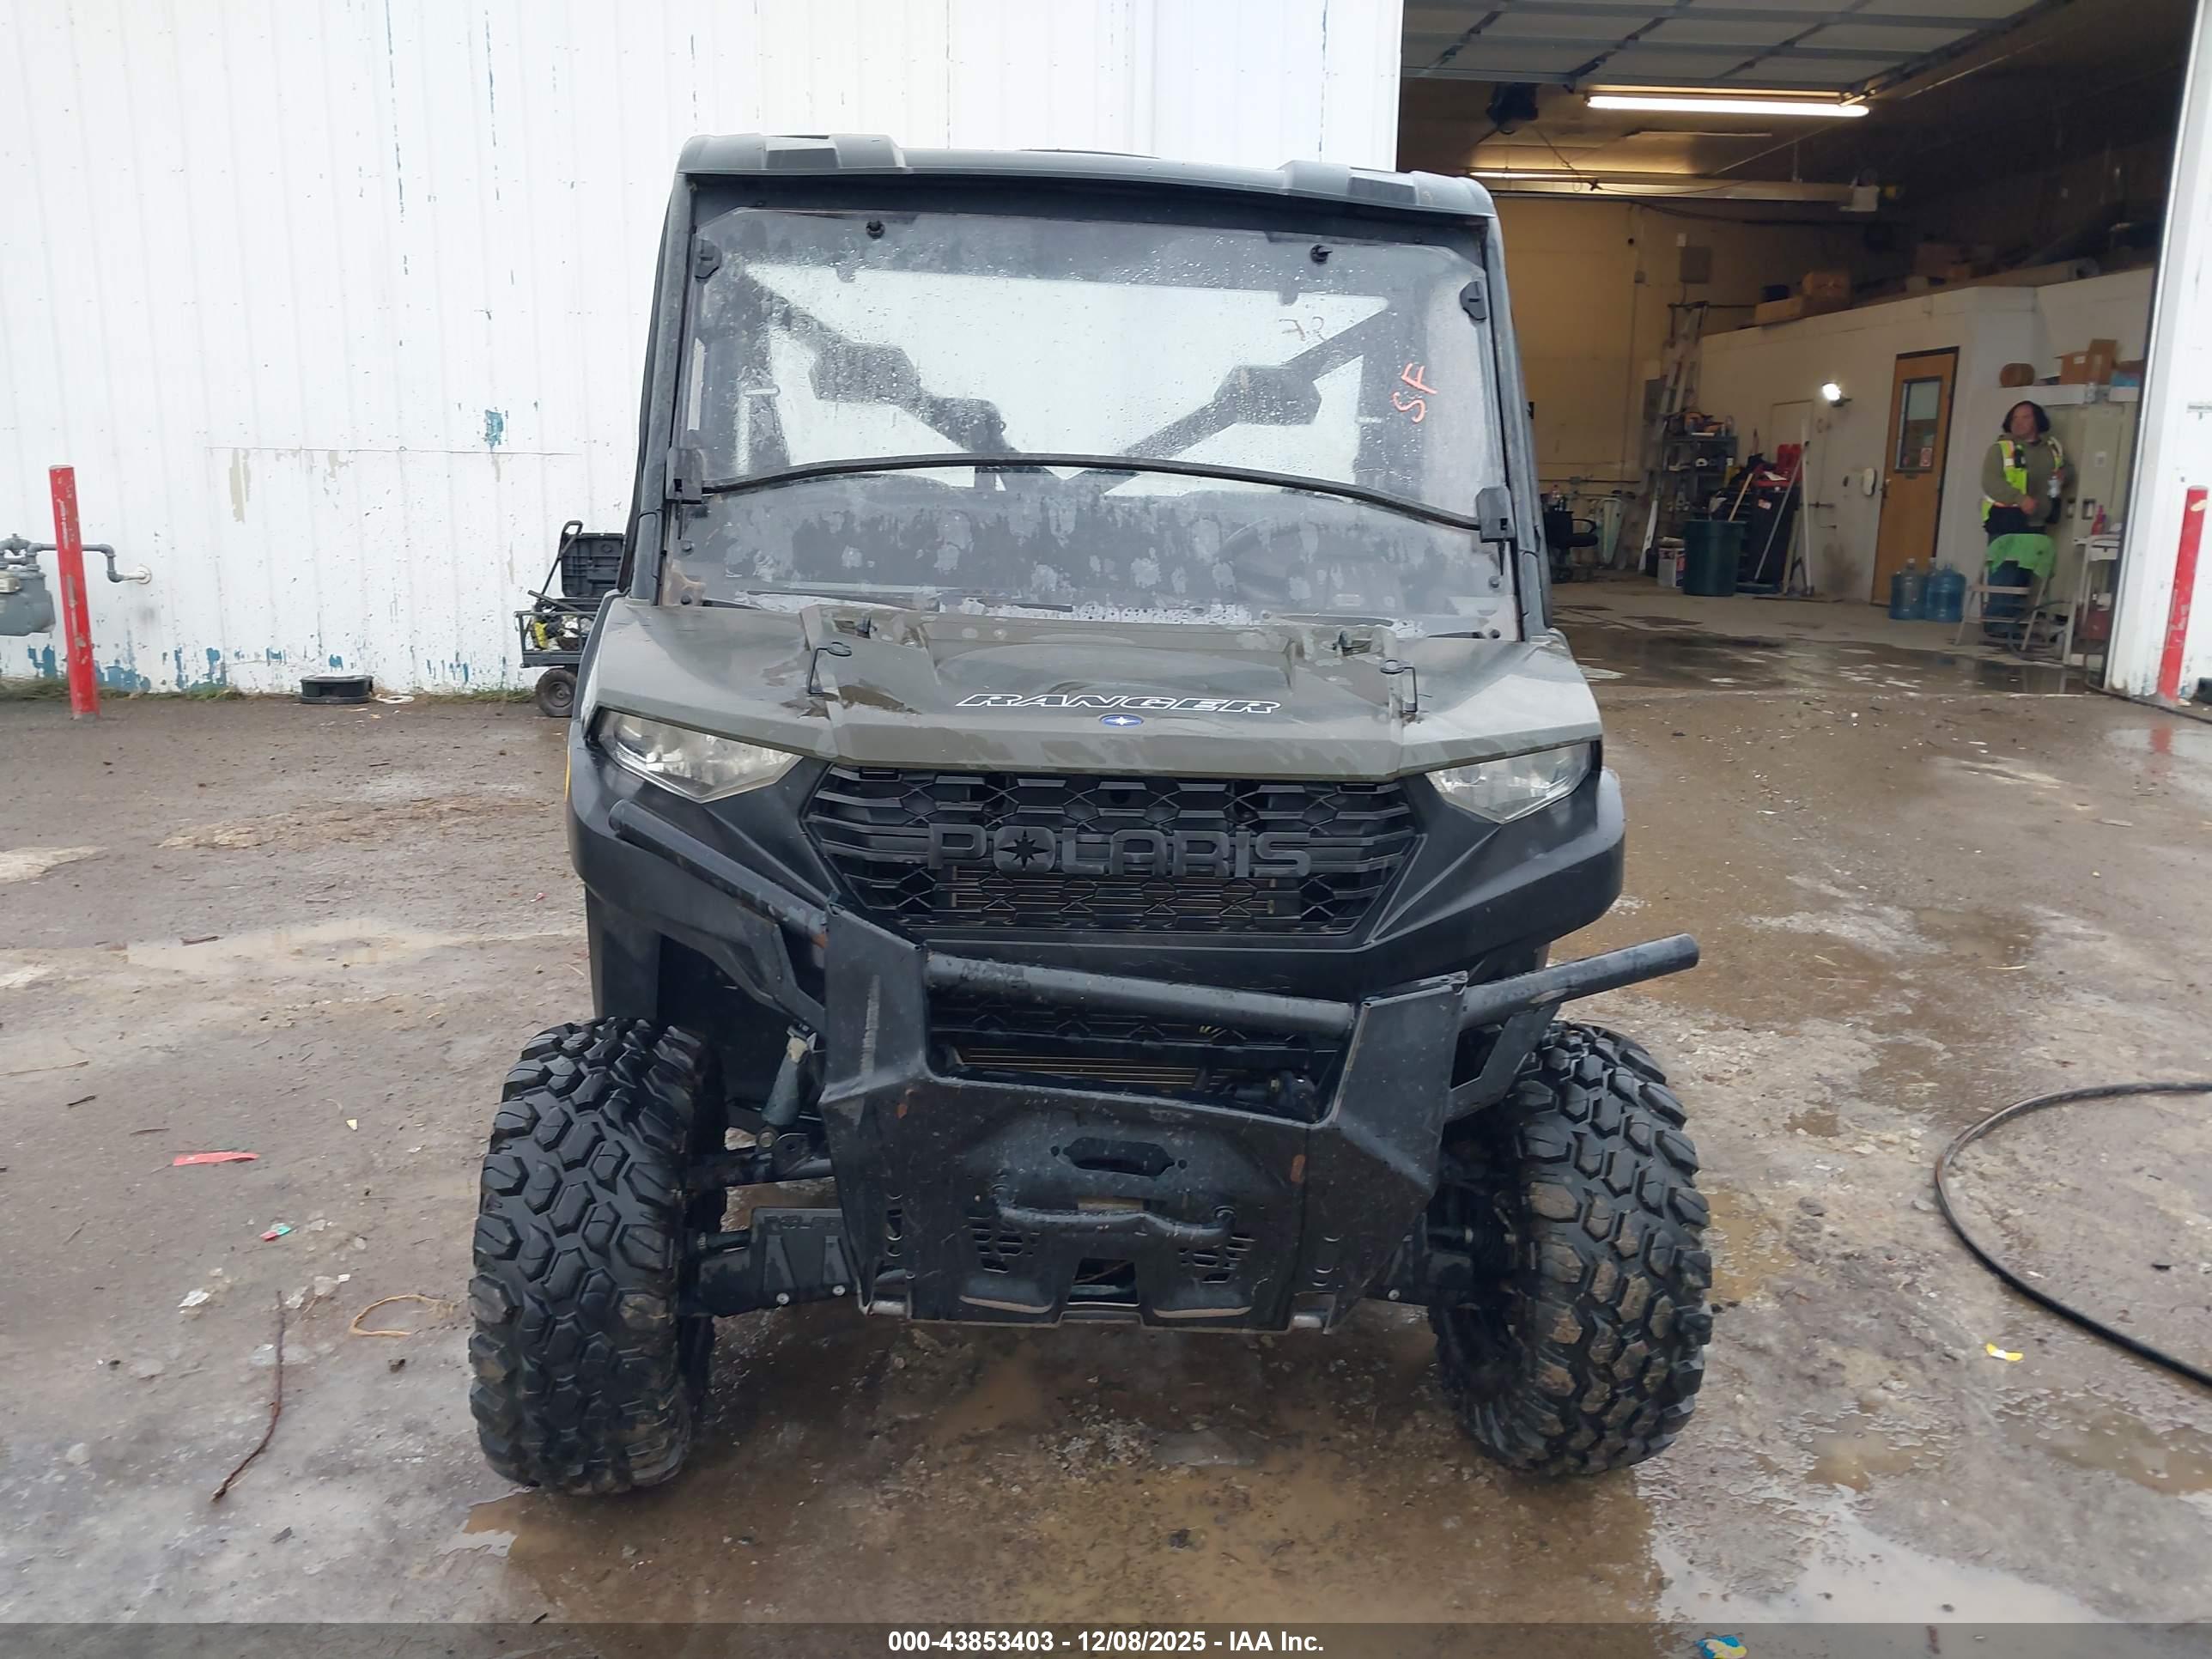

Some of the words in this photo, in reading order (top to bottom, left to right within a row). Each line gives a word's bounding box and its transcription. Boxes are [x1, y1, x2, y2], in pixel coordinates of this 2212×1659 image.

[1391, 362, 1437, 423] SF
[955, 694, 1281, 714] RANGER
[927, 823, 1311, 878] POLARIS
